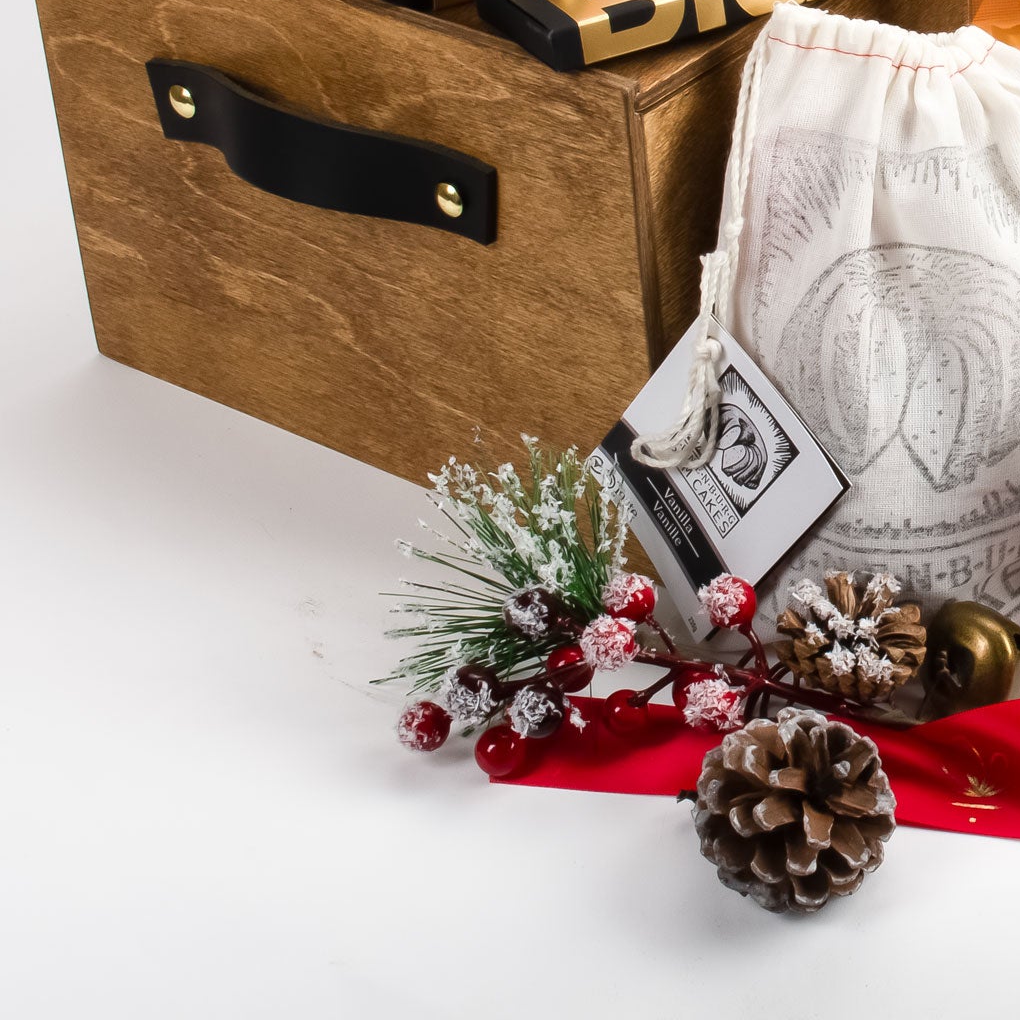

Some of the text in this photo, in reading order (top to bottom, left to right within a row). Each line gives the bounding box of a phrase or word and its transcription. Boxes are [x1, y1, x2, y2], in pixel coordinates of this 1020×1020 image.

[653, 499, 683, 547] Vanille
[663, 486, 694, 535] Vanilla
[693, 478, 730, 534] CAKES
